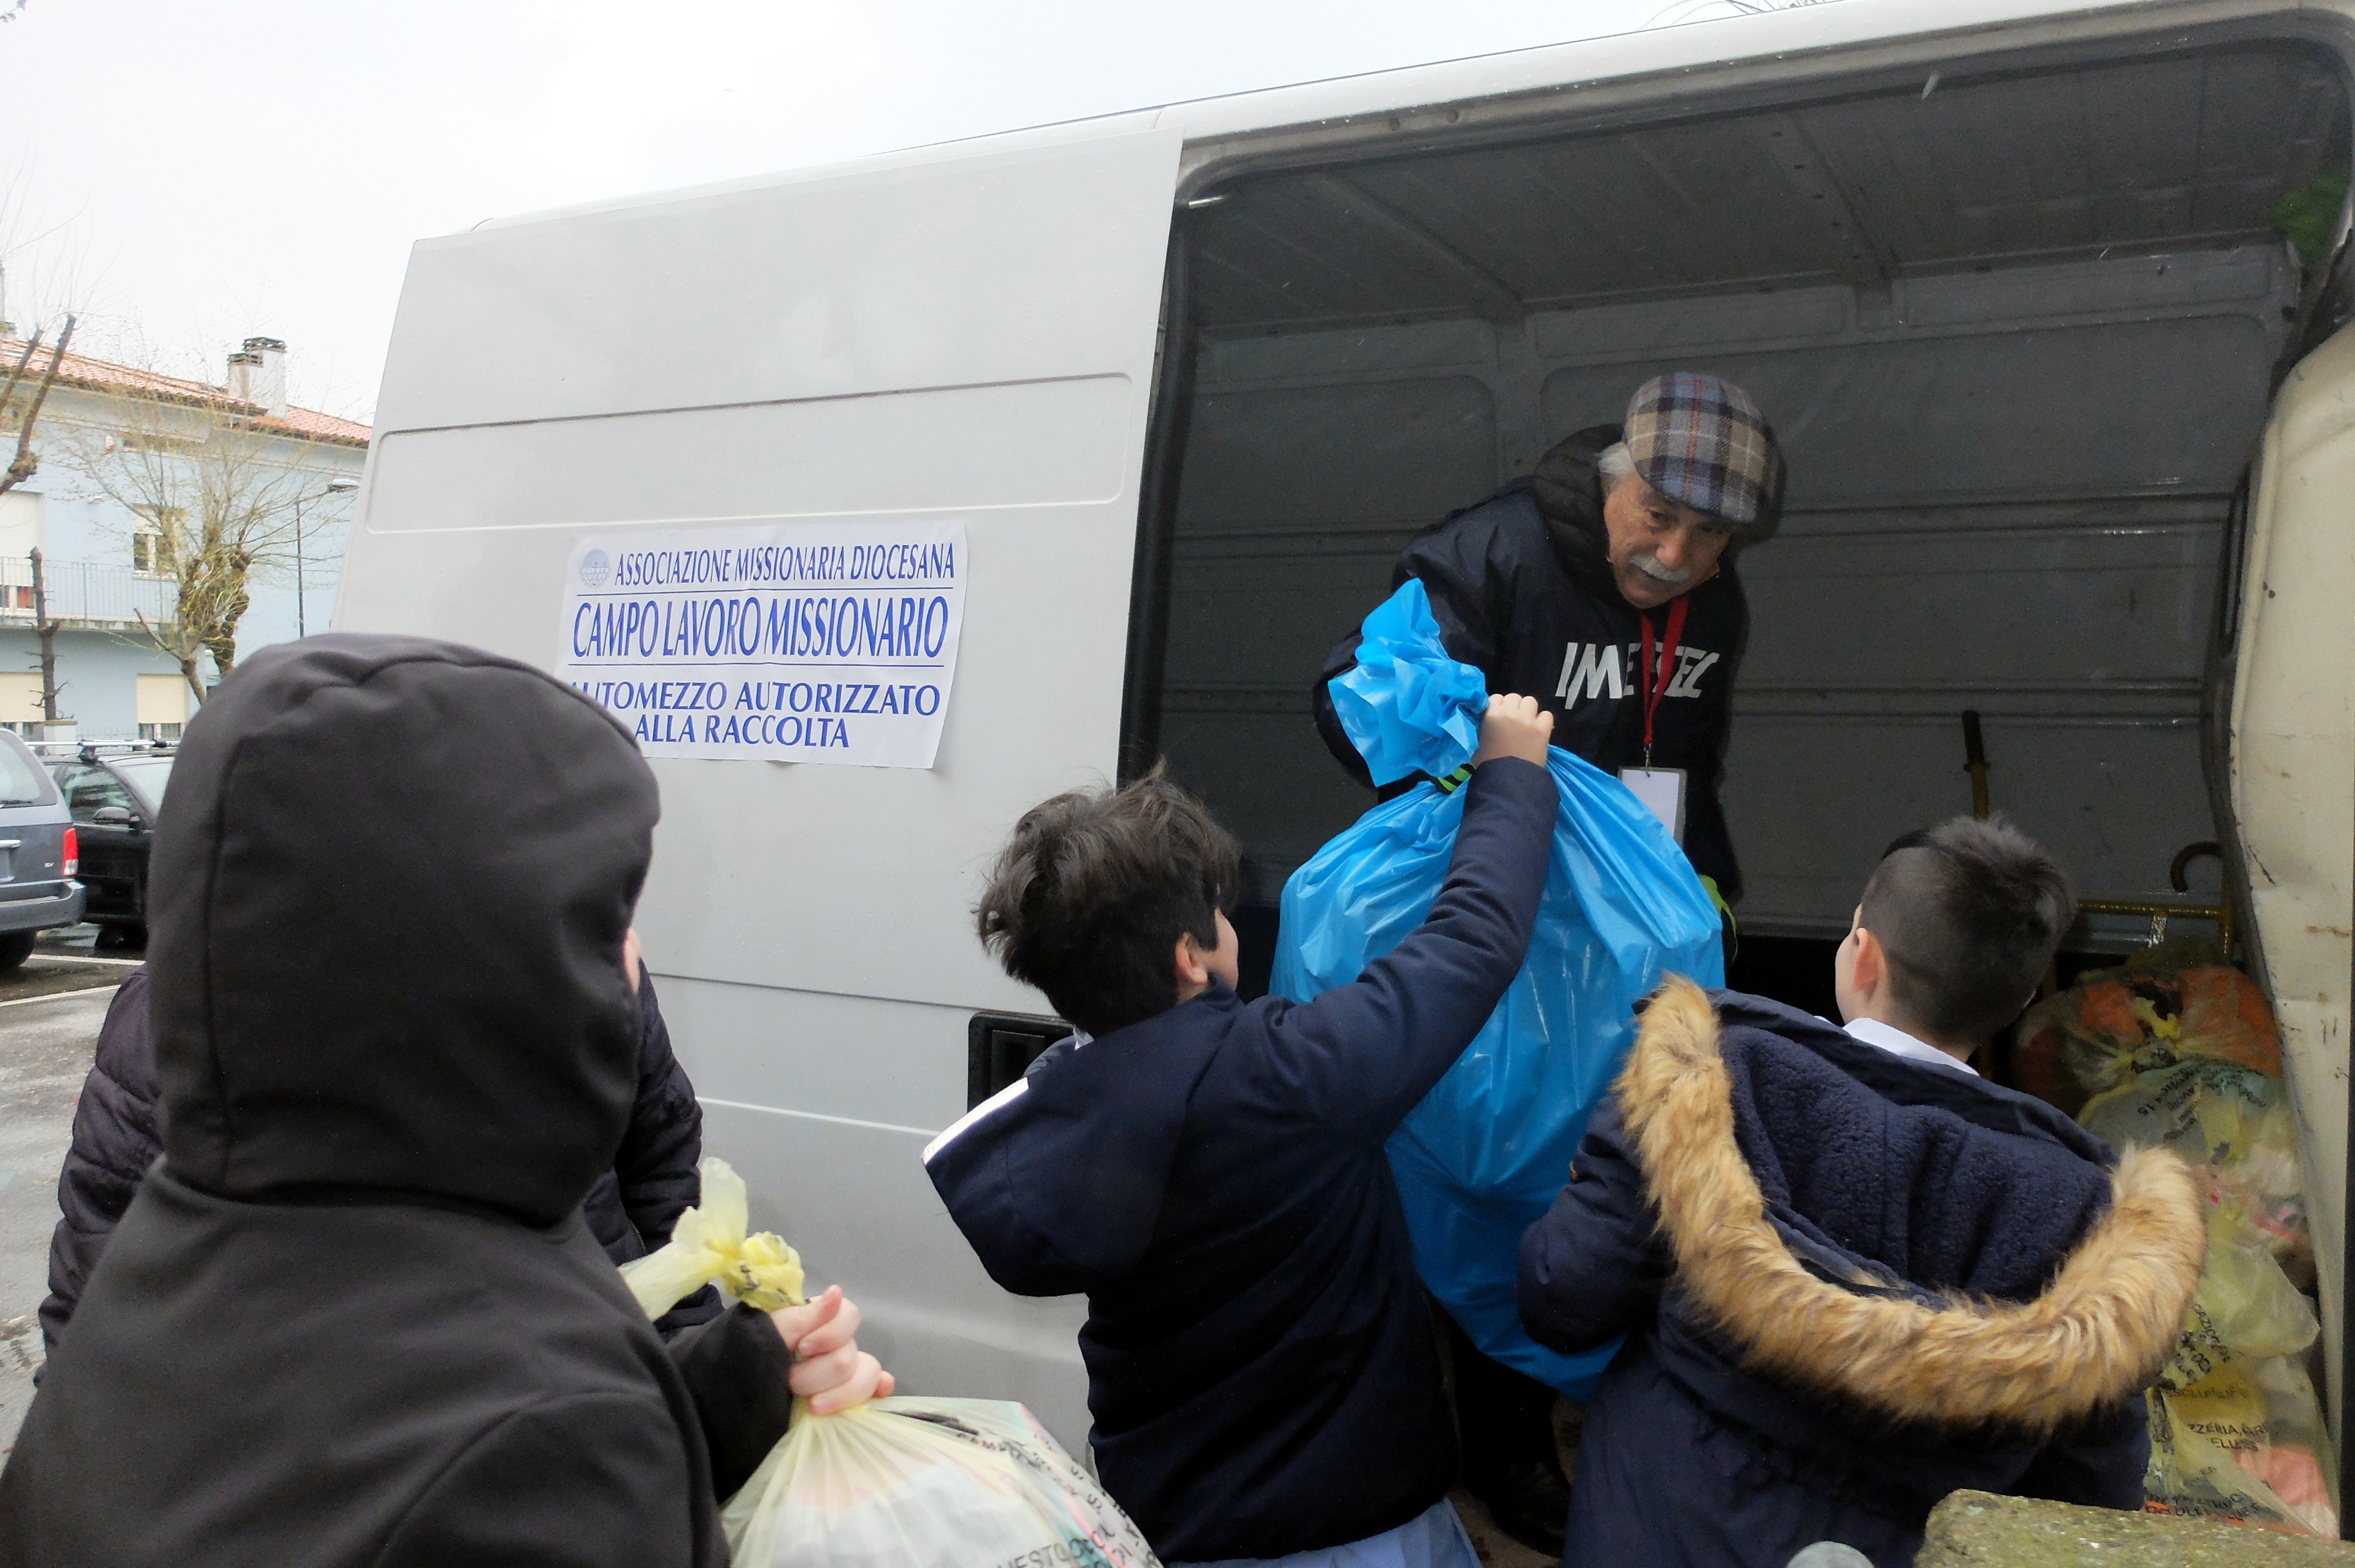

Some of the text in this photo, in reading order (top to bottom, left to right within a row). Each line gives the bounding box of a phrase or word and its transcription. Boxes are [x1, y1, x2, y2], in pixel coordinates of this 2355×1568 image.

[615, 543, 955, 586] ASSOCIAZIONE MISSIONARIA DIOCESANA
[573, 596, 948, 658] CAMPO LAVORO MISSIONARIO
[734, 681, 941, 716] AUTORIZZATO
[634, 713, 850, 748] ALLA RACCOLTA
